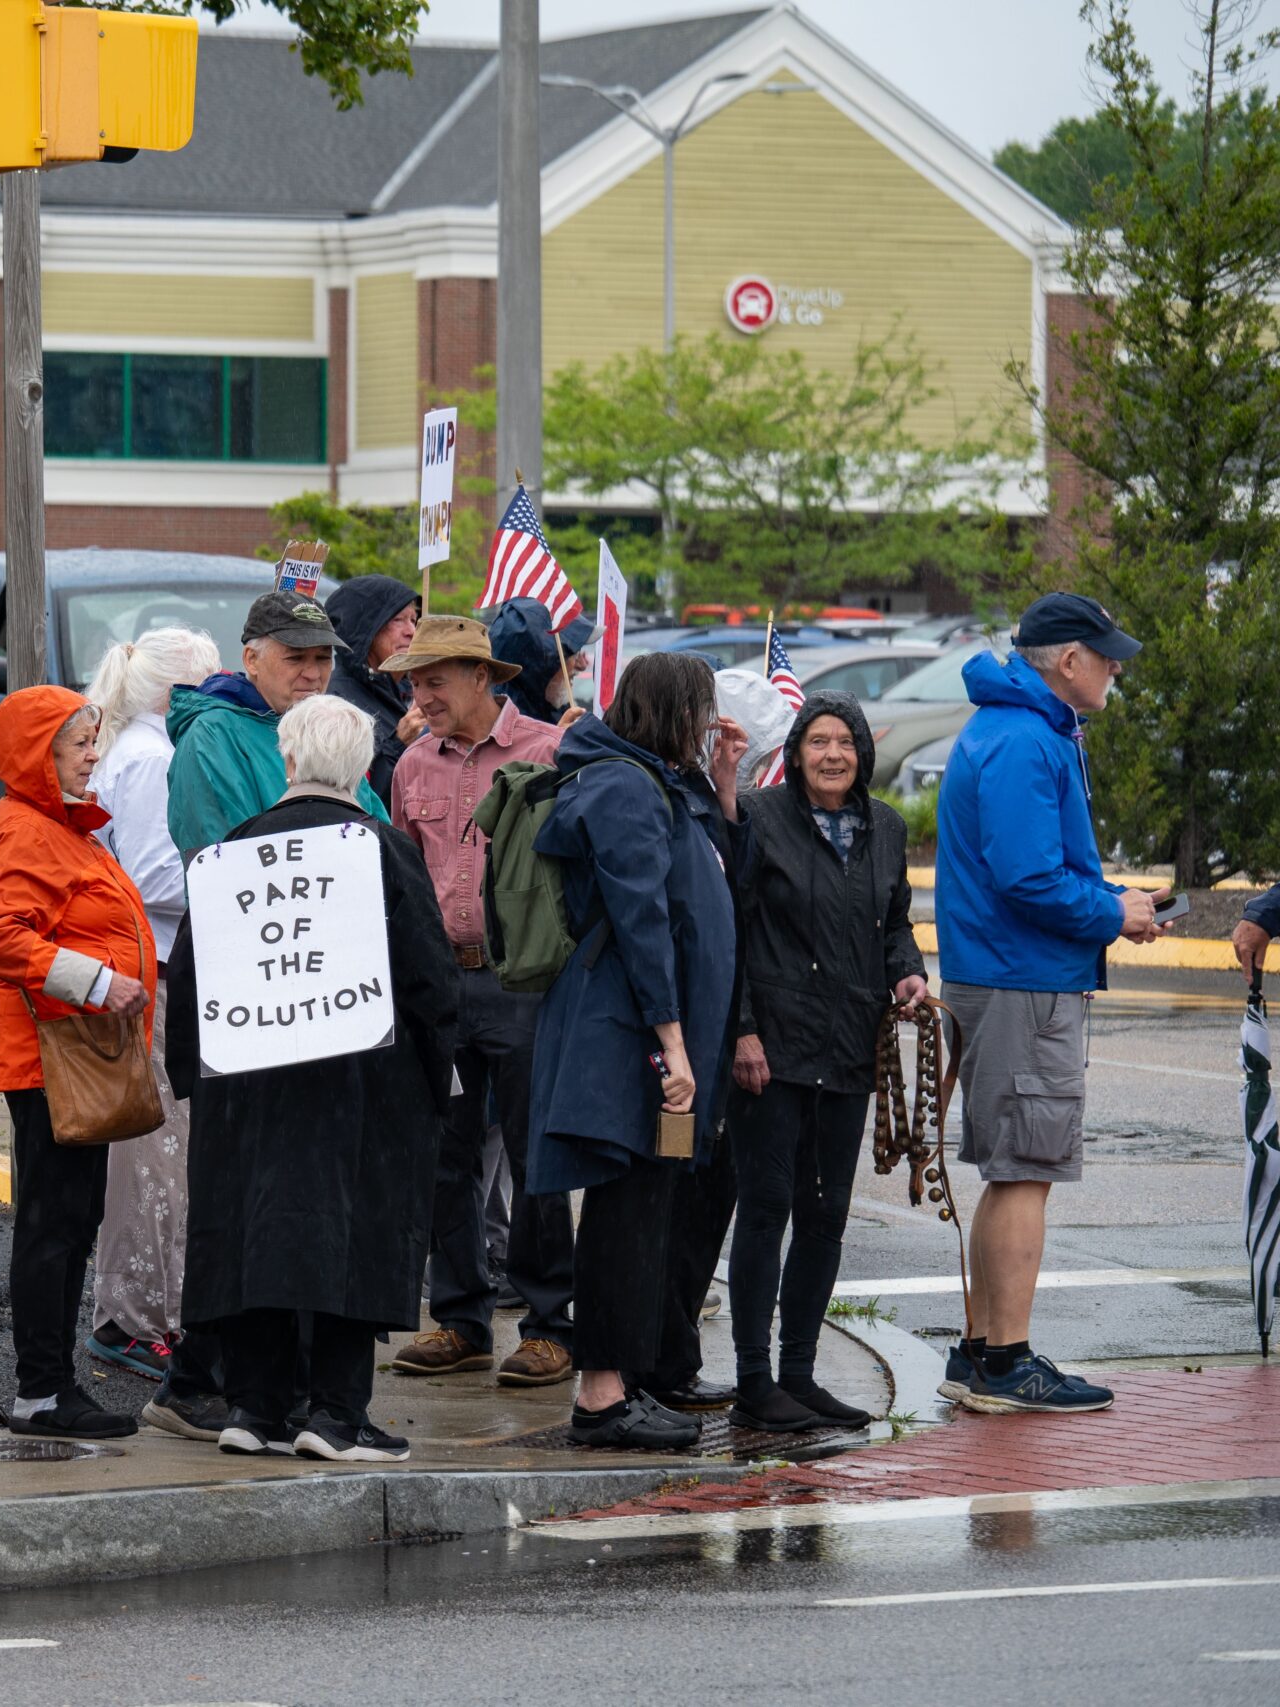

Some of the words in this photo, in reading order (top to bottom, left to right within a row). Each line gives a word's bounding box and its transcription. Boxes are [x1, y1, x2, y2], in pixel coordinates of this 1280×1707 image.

[425, 420, 455, 467] DUMP
[284, 562, 302, 577] THIS
[302, 564, 310, 578] IS
[310, 564, 321, 579] MY
[257, 839, 303, 868] BE
[235, 876, 334, 914] PART
[260, 917, 312, 944] OF
[257, 951, 324, 981] THE
